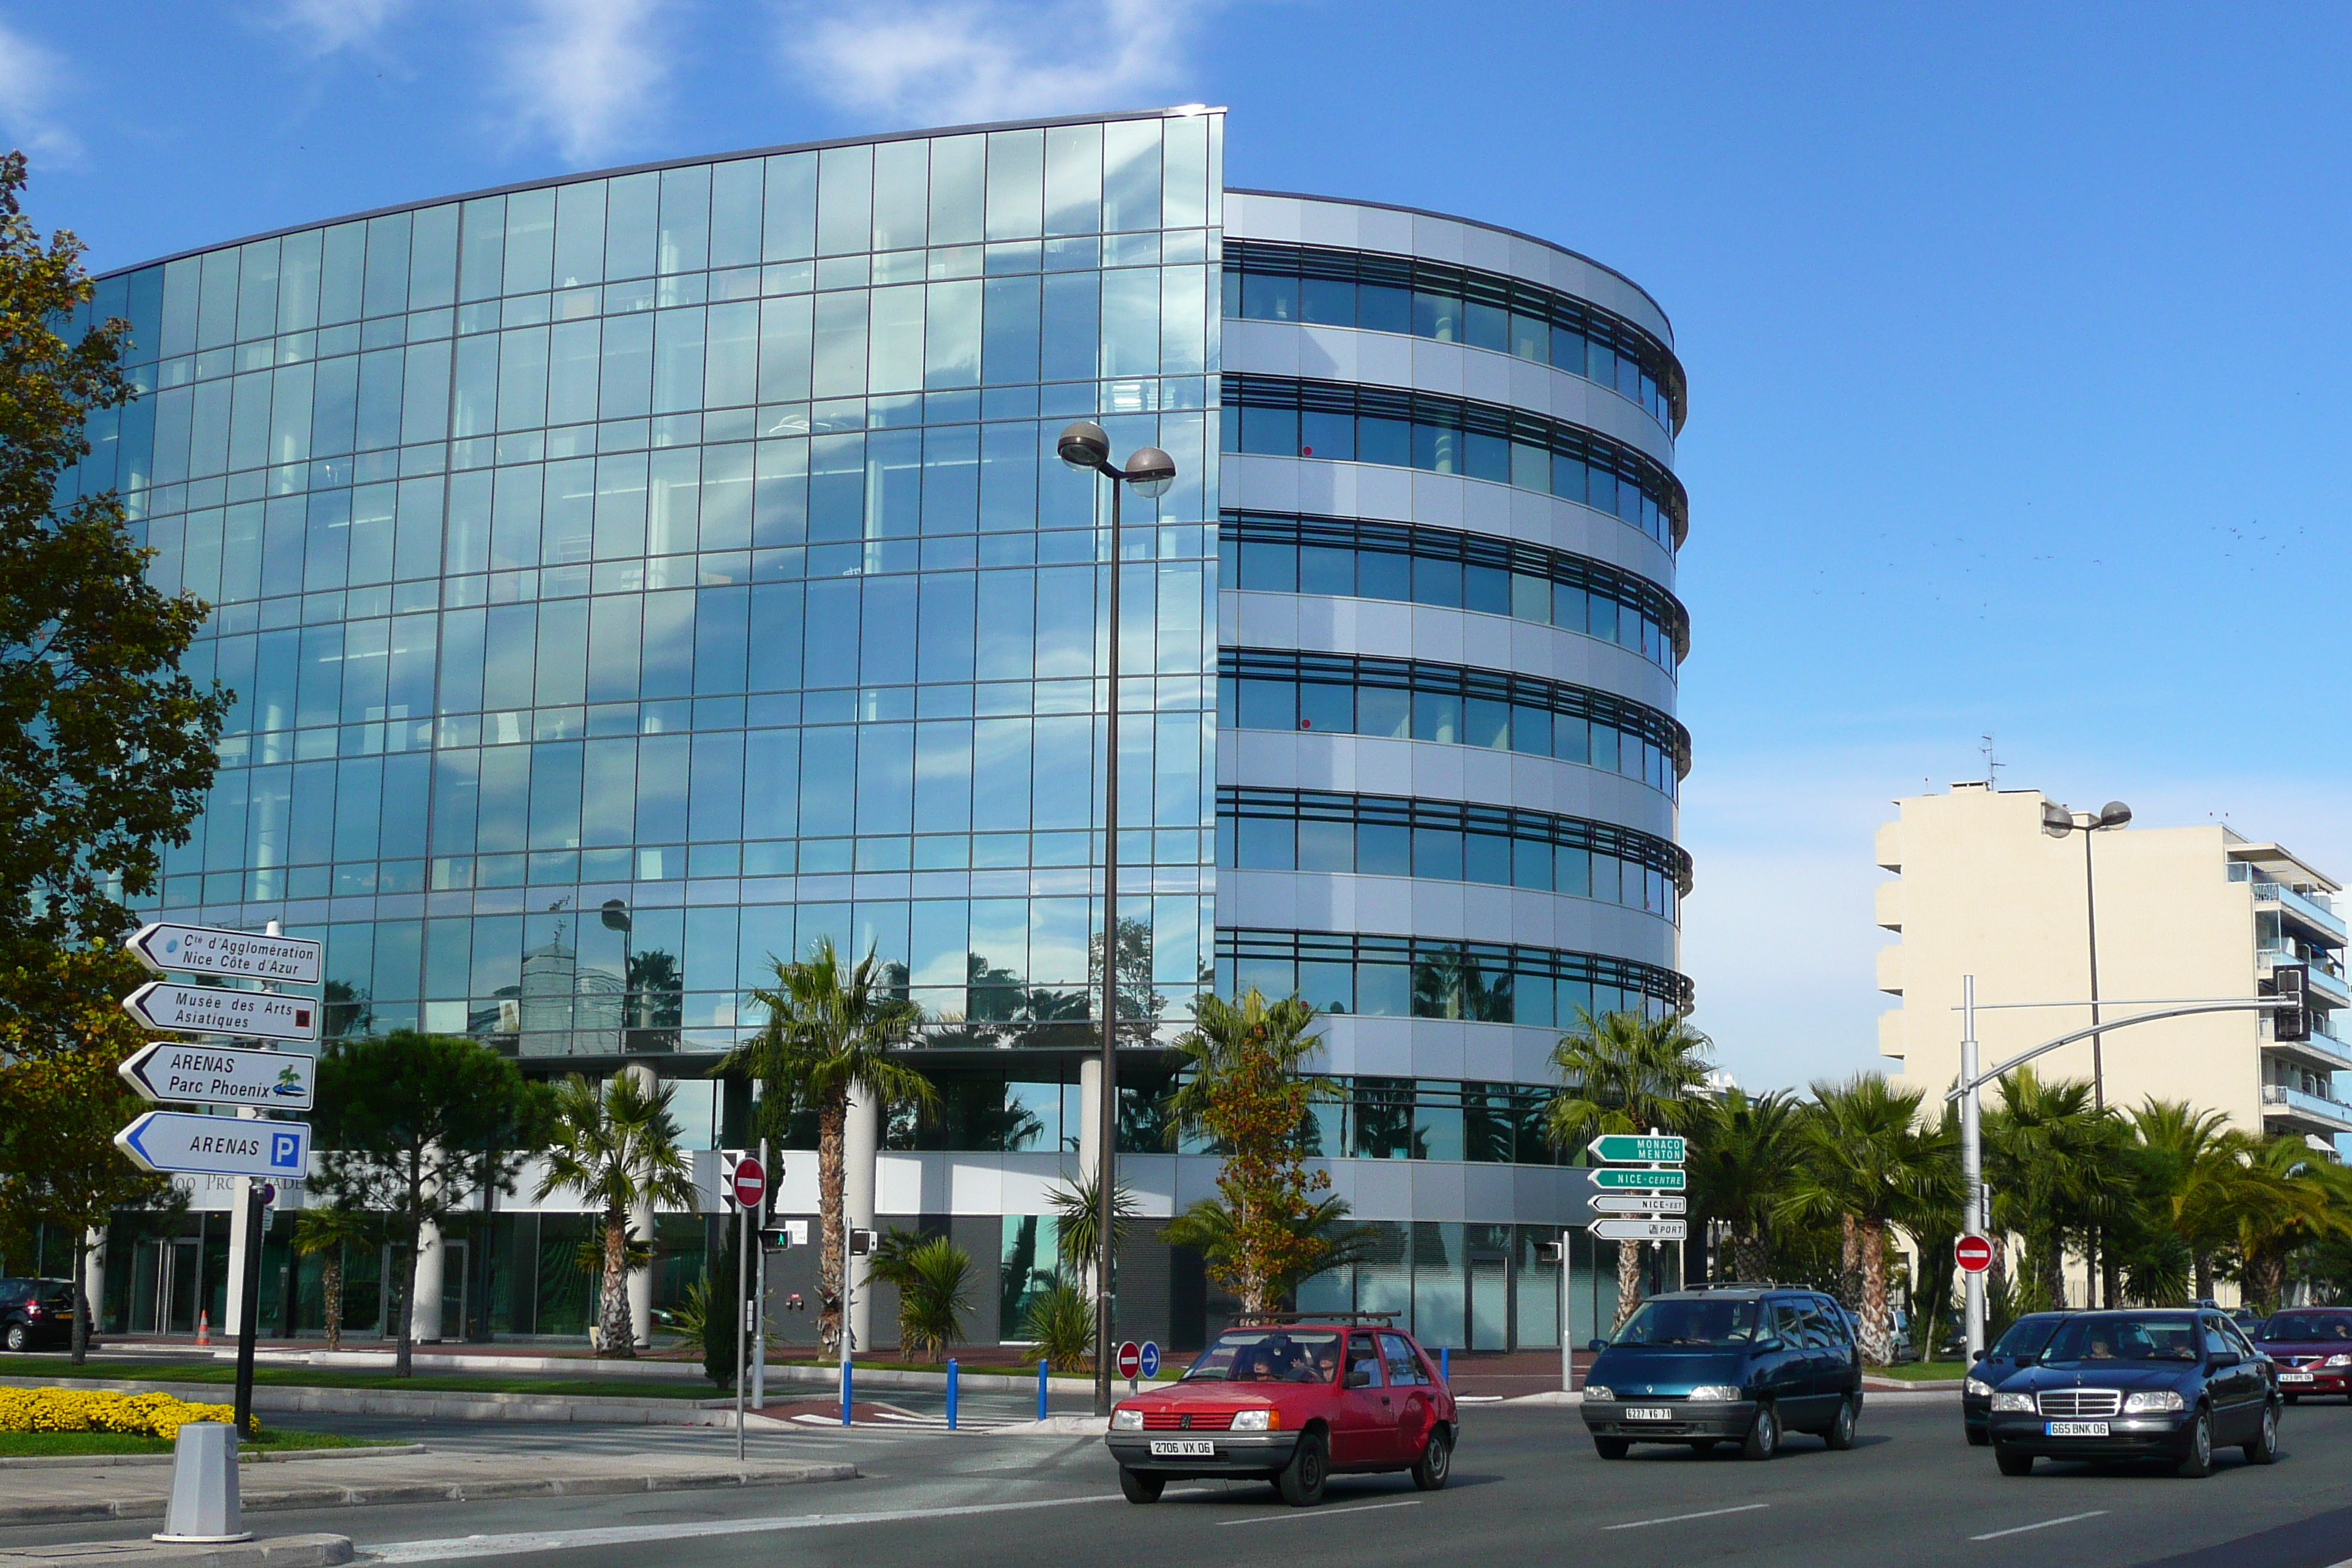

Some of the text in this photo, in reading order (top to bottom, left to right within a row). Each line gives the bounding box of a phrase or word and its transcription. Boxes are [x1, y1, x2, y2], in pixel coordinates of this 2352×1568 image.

[208, 937, 314, 960] d'Agglomération
[183, 951, 298, 974] Nice Côte d'Azur
[176, 992, 293, 1015] Musée des Arts
[175, 1009, 249, 1028] Asiatiques
[170, 1053, 235, 1073] ARENAS
[169, 1076, 271, 1098] Parc Phoenix
[189, 1136, 294, 1163] ARENAS P
[1637, 1139, 1680, 1149] MONACO
[1638, 1150, 1680, 1159] MENTON
[1660, 1226, 1682, 1234] PORT
[2052, 1423, 2106, 1433] 665 BNK 06
[1155, 1442, 1210, 1453] 2706 VX 06
